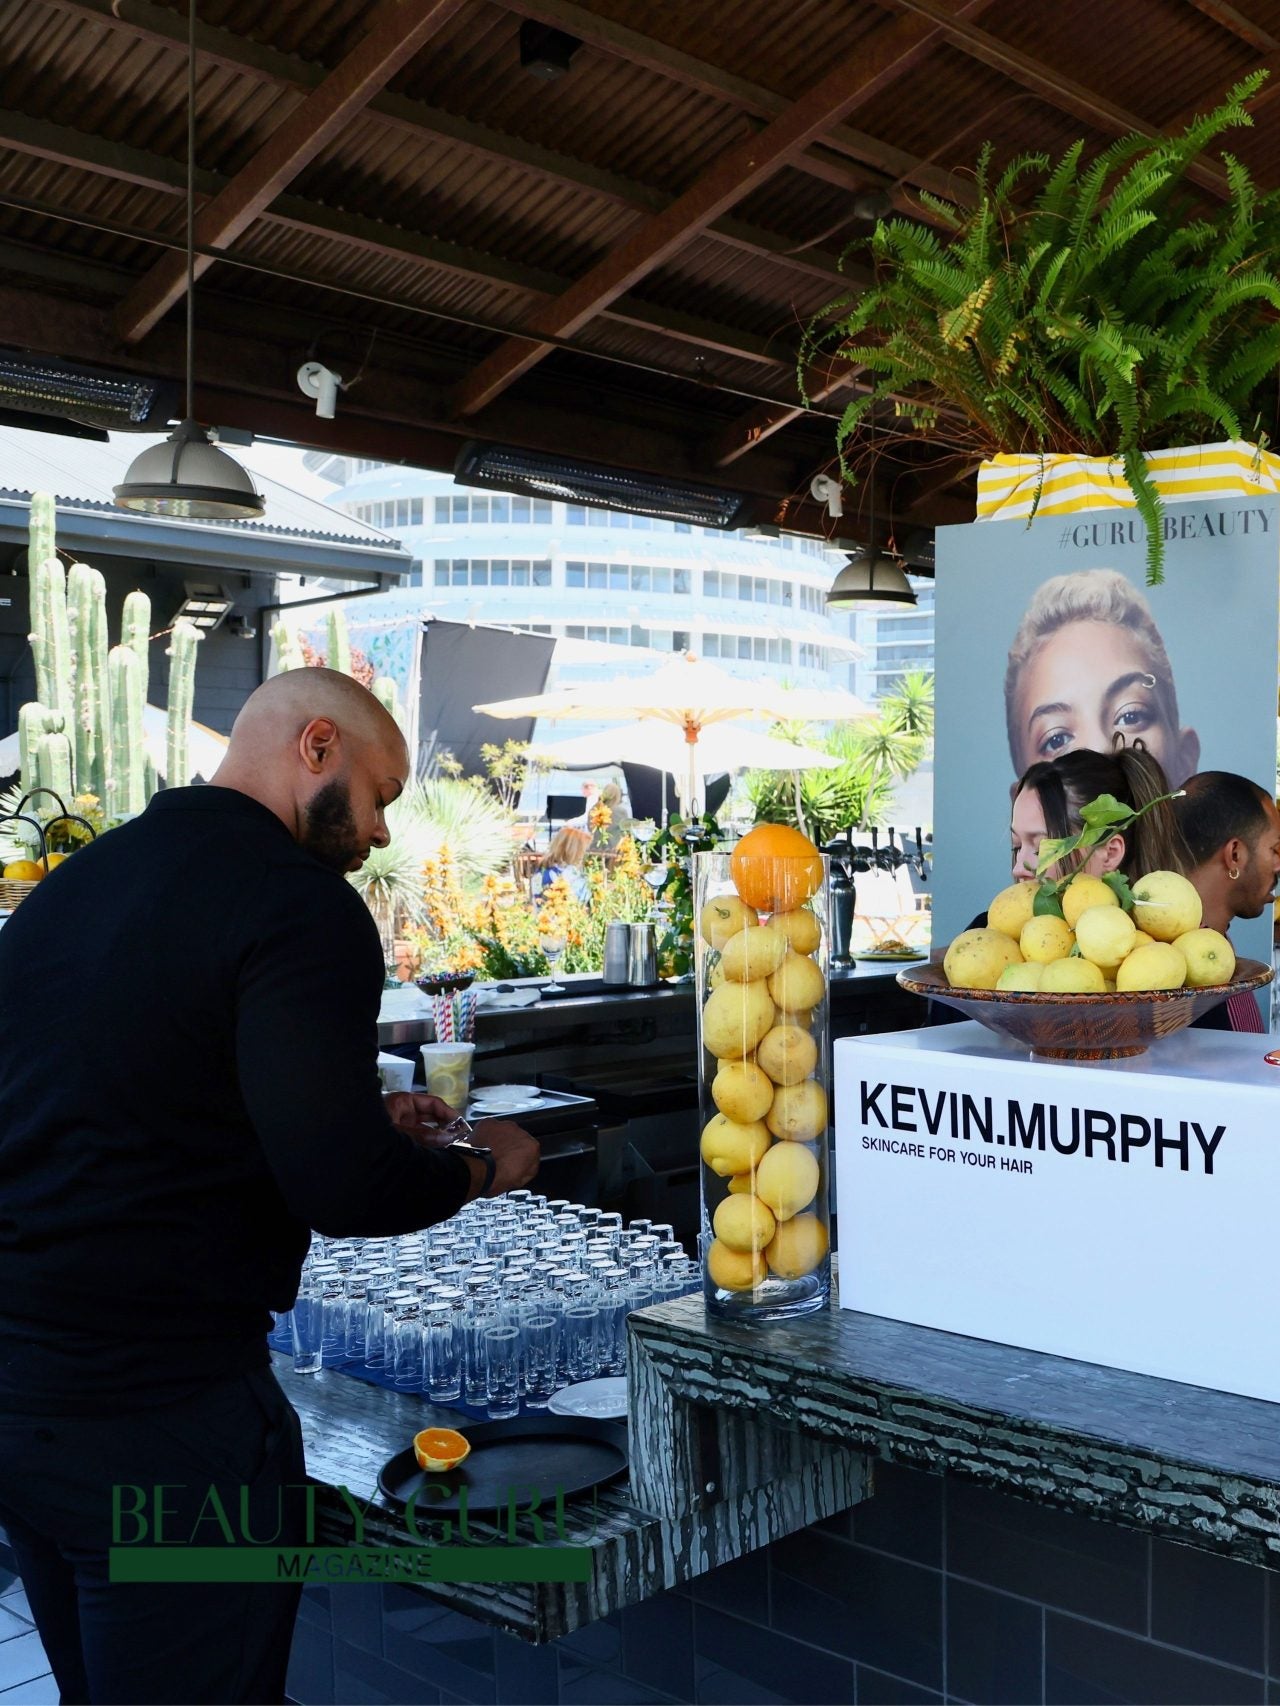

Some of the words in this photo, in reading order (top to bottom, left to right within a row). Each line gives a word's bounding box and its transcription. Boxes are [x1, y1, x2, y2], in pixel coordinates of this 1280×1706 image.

[860, 1080, 1227, 1175] KEVIN.MURPHY
[861, 1136, 925, 1158] SKINCARE
[929, 1146, 956, 1163] FOR
[960, 1150, 996, 1169] YOUR
[1000, 1157, 1033, 1175] HAIR
